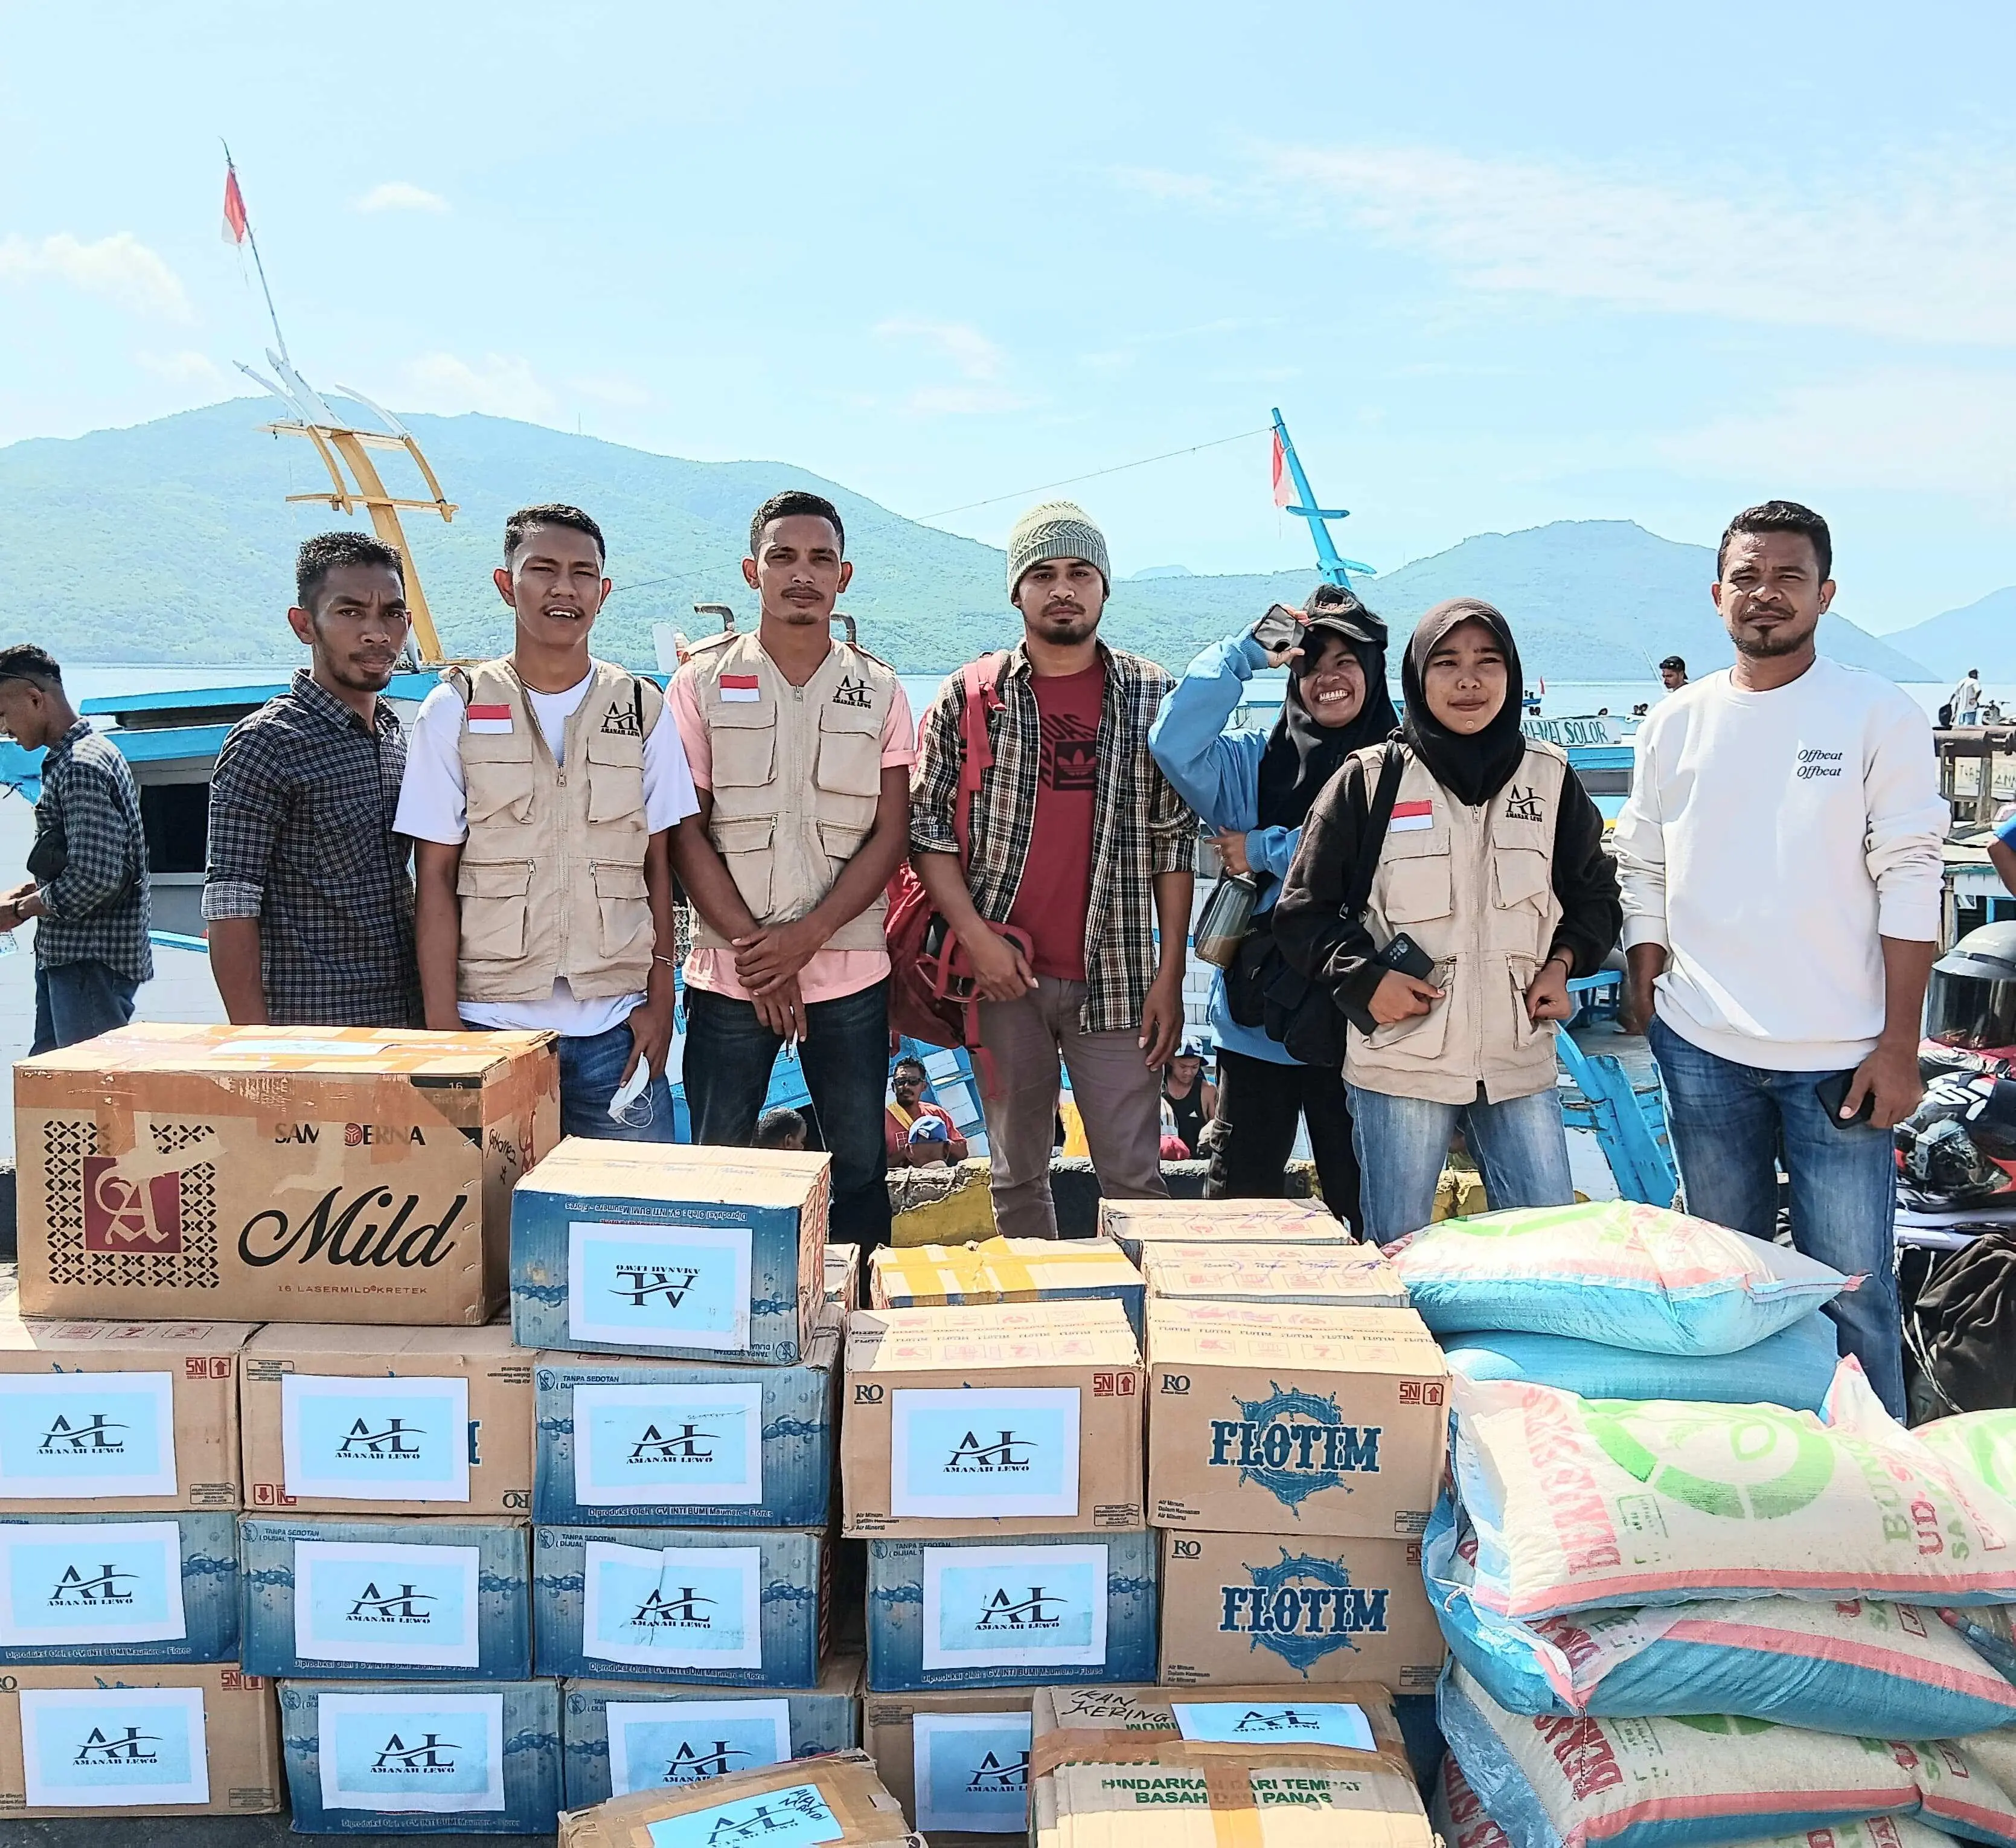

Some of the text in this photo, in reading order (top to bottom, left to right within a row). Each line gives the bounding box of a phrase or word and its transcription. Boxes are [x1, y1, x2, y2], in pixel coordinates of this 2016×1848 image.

[1564, 720, 1608, 744] SOLOR
[1797, 749, 1843, 762] Offbeat
[1797, 766, 1842, 779] Offbeat
[565, 1202, 589, 1212] Flores
[595, 1203, 630, 1215] Maumere
[631, 1207, 651, 1216] BUMI
[653, 1208, 667, 1217] INTI
[687, 1210, 706, 1219] Oleh
[707, 1211, 747, 1221] Diproduksi
[238, 1185, 467, 1267] Mild
[651, 1265, 700, 1274] AMANAH
[186, 1359, 206, 1374] SNI
[1093, 1375, 1114, 1391] SNI
[1162, 1375, 1190, 1391] RO
[1400, 1383, 1420, 1399] SNI
[855, 1385, 883, 1400] RO
[37, 1414, 124, 1448] AL
[336, 1417, 420, 1452] AL
[627, 1424, 714, 1457] AL
[944, 1431, 1030, 1465] AL
[1209, 1420, 1381, 1472] FLOTIM
[502, 1493, 531, 1509] RO
[1174, 1540, 1202, 1556] RO
[49, 1564, 133, 1599] AL
[347, 1582, 431, 1618] AL
[976, 1587, 1060, 1624] AL
[1220, 1587, 1389, 1632] FLOTIM
[222, 1671, 242, 1687] SNI
[1070, 1690, 1136, 1707] IKAN
[1061, 1699, 1171, 1722] KERING
[74, 1727, 158, 1759] AL
[371, 1733, 455, 1767] AL
[1135, 1792, 1208, 1804] BASAH
[1262, 1792, 1333, 1804] PANAS
